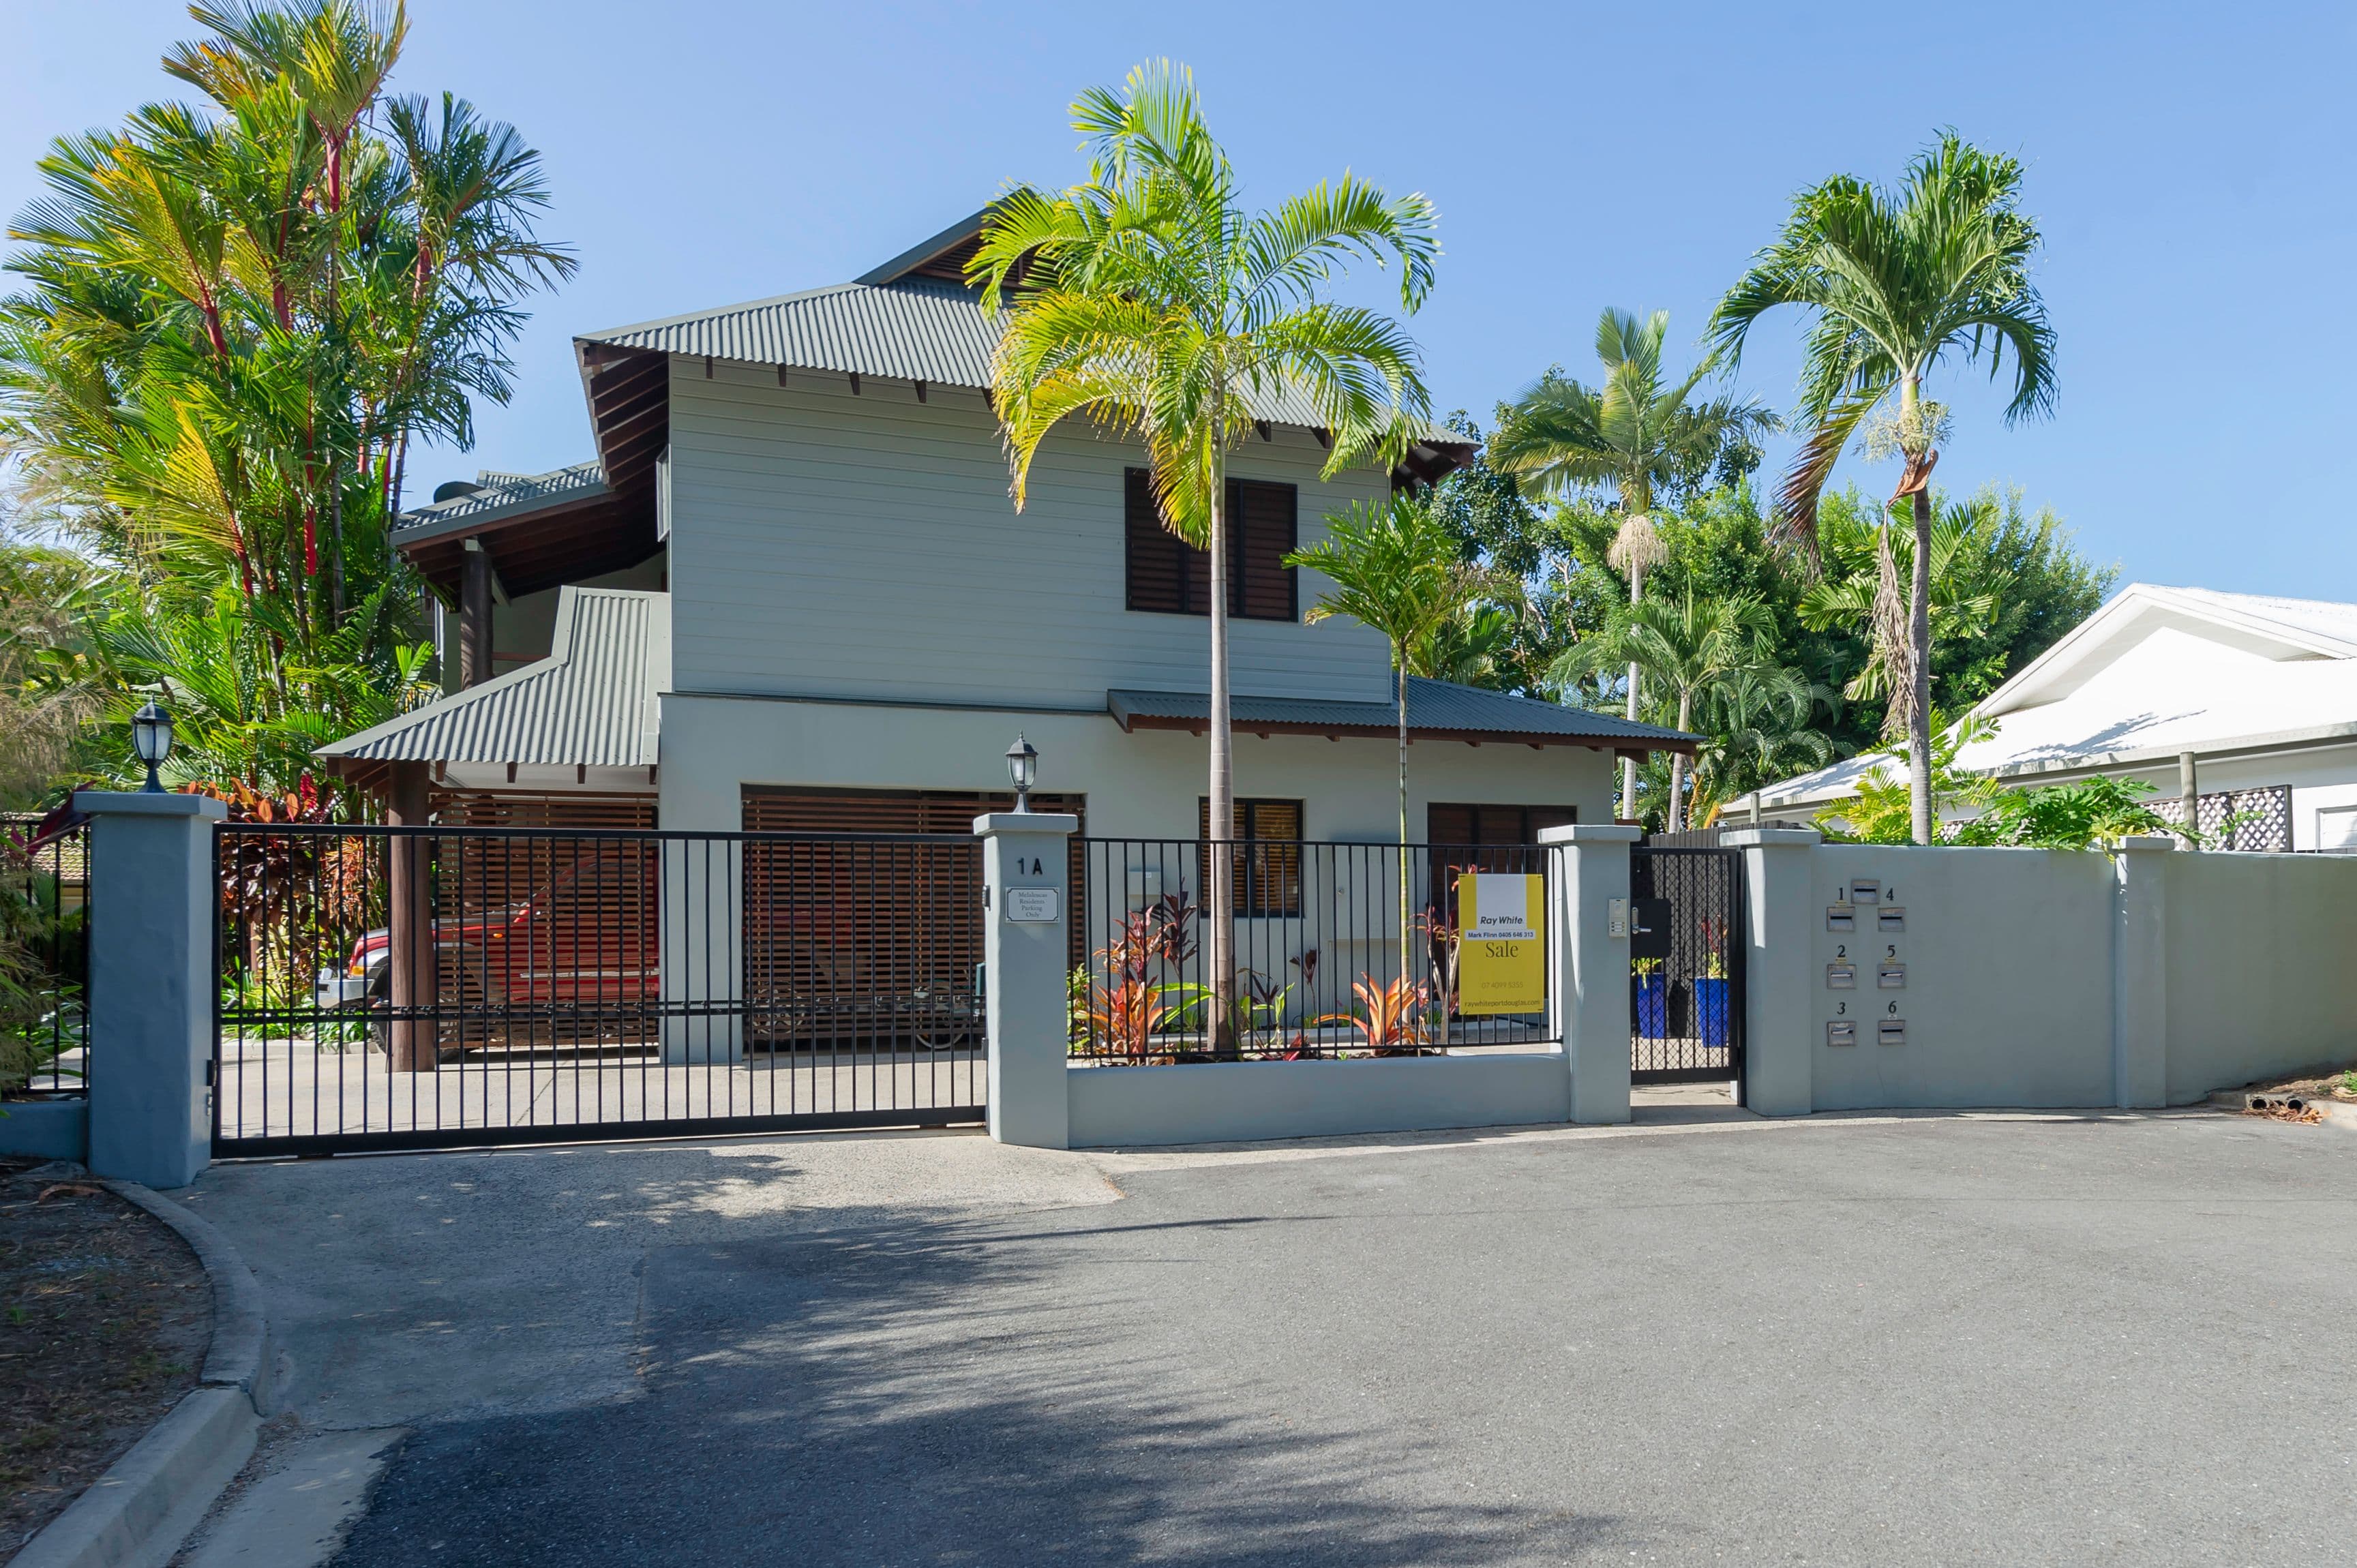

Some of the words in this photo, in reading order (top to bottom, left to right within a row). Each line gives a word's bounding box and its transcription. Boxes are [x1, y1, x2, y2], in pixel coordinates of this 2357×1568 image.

[1839, 887, 1844, 900] 1
[1886, 887, 1894, 901] 4
[1480, 916, 1497, 925] Ray
[1499, 916, 1523, 924] White
[1485, 941, 1519, 958] Sale
[1837, 944, 1846, 957] 2
[1887, 945, 1895, 957] 5
[1465, 999, 1540, 1007] raywhiteportdouglas.com
[1837, 1001, 1846, 1014] 3
[1888, 1000, 1897, 1014] 6
